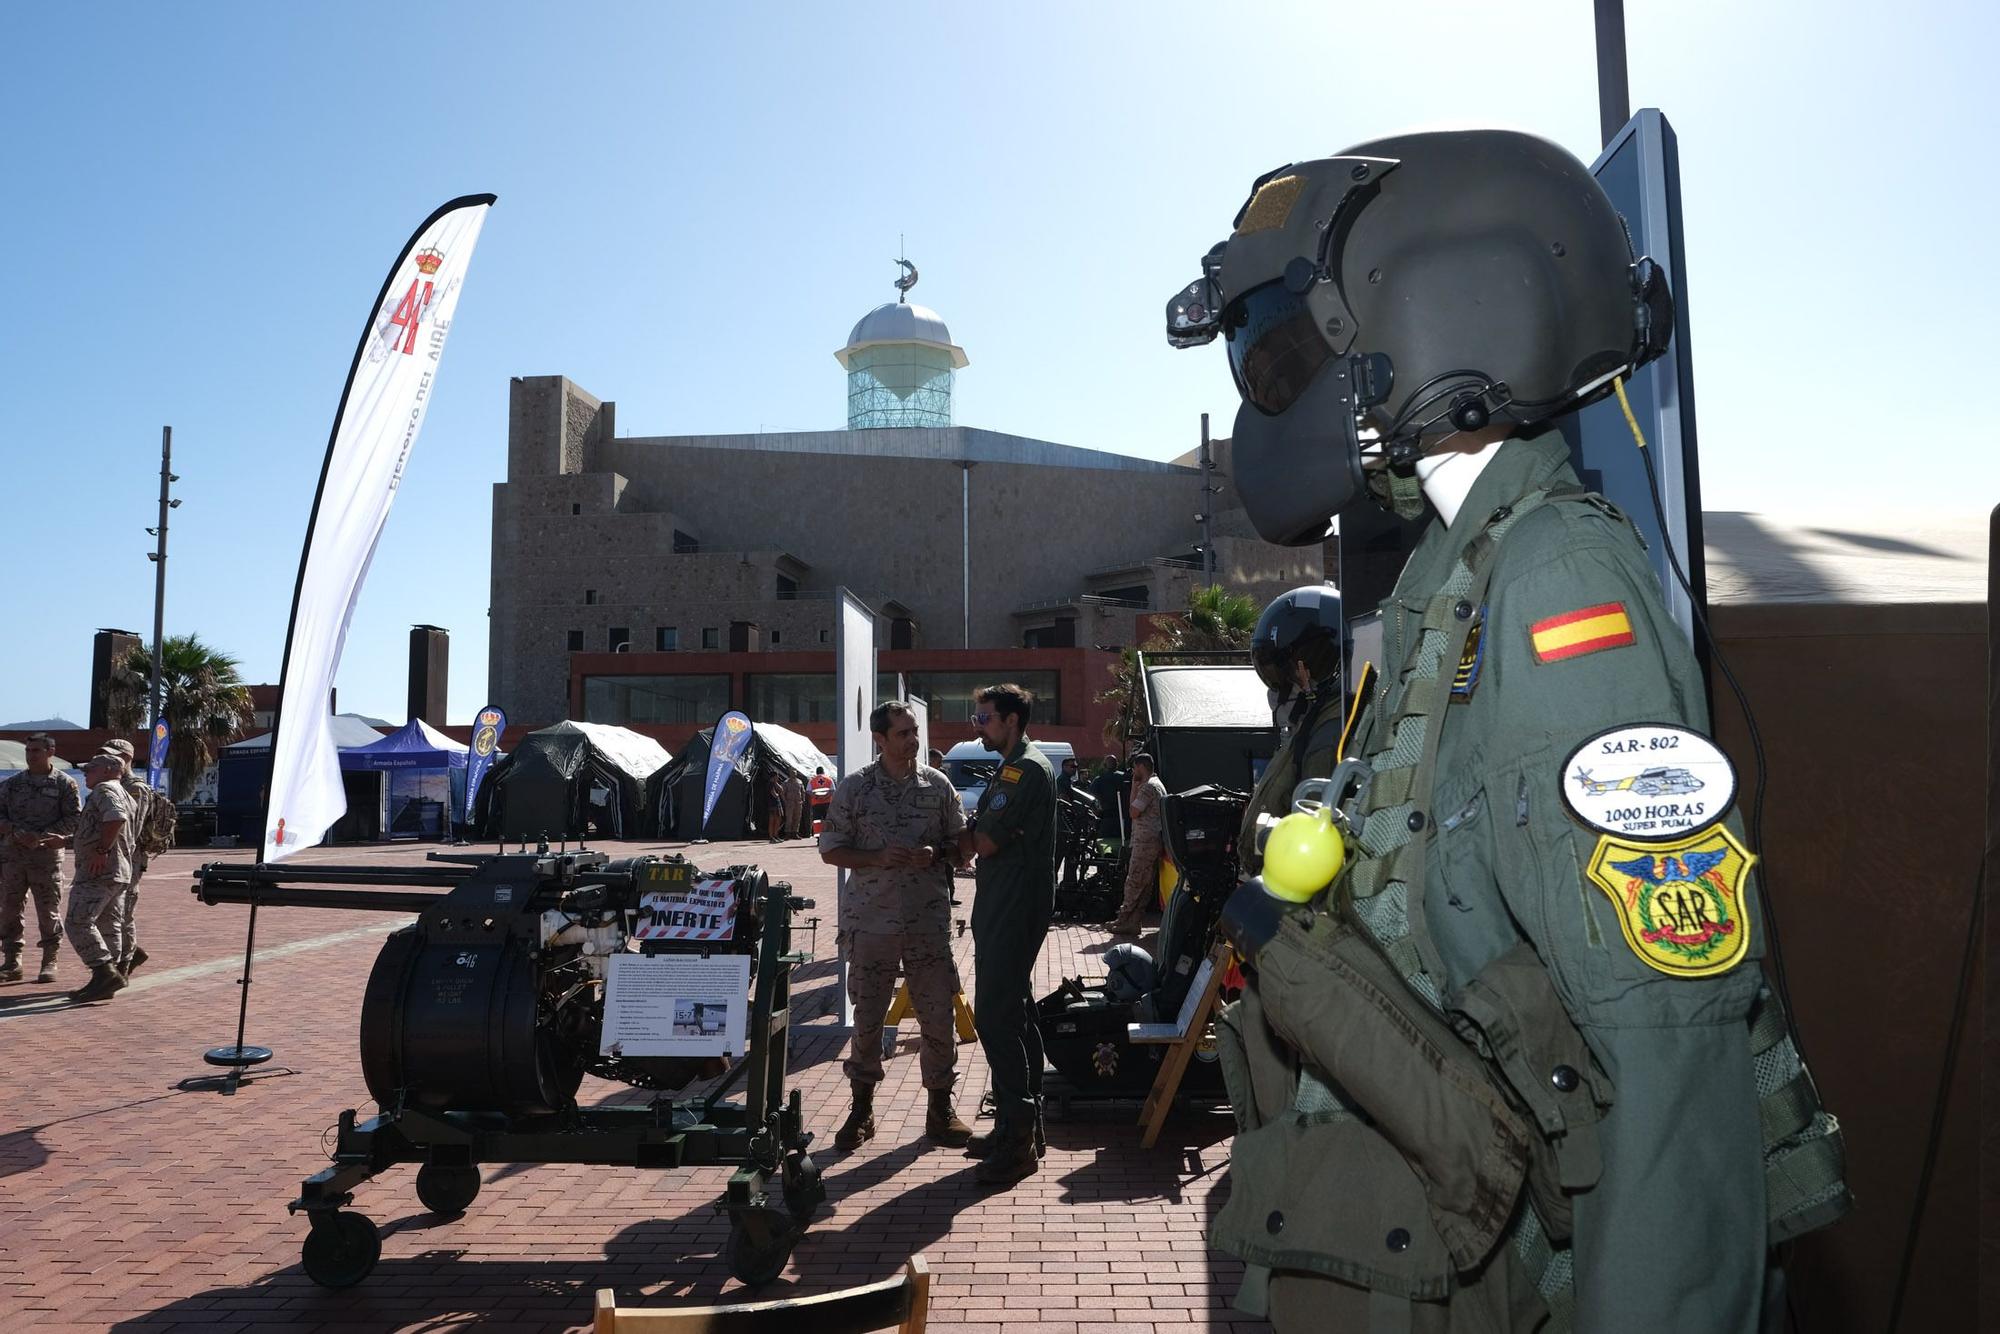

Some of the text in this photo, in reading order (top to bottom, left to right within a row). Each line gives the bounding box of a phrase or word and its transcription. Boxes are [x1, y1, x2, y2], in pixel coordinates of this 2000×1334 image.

[427, 317, 450, 362] AIRE
[1605, 802, 1705, 823] 1000 HORAS
[1622, 818, 1694, 831] SUPER PUMA
[648, 867, 685, 881] TAR
[689, 897, 718, 908] EXPUESTO
[1657, 888, 1710, 935] SAR
[650, 910, 722, 929] INERTE
